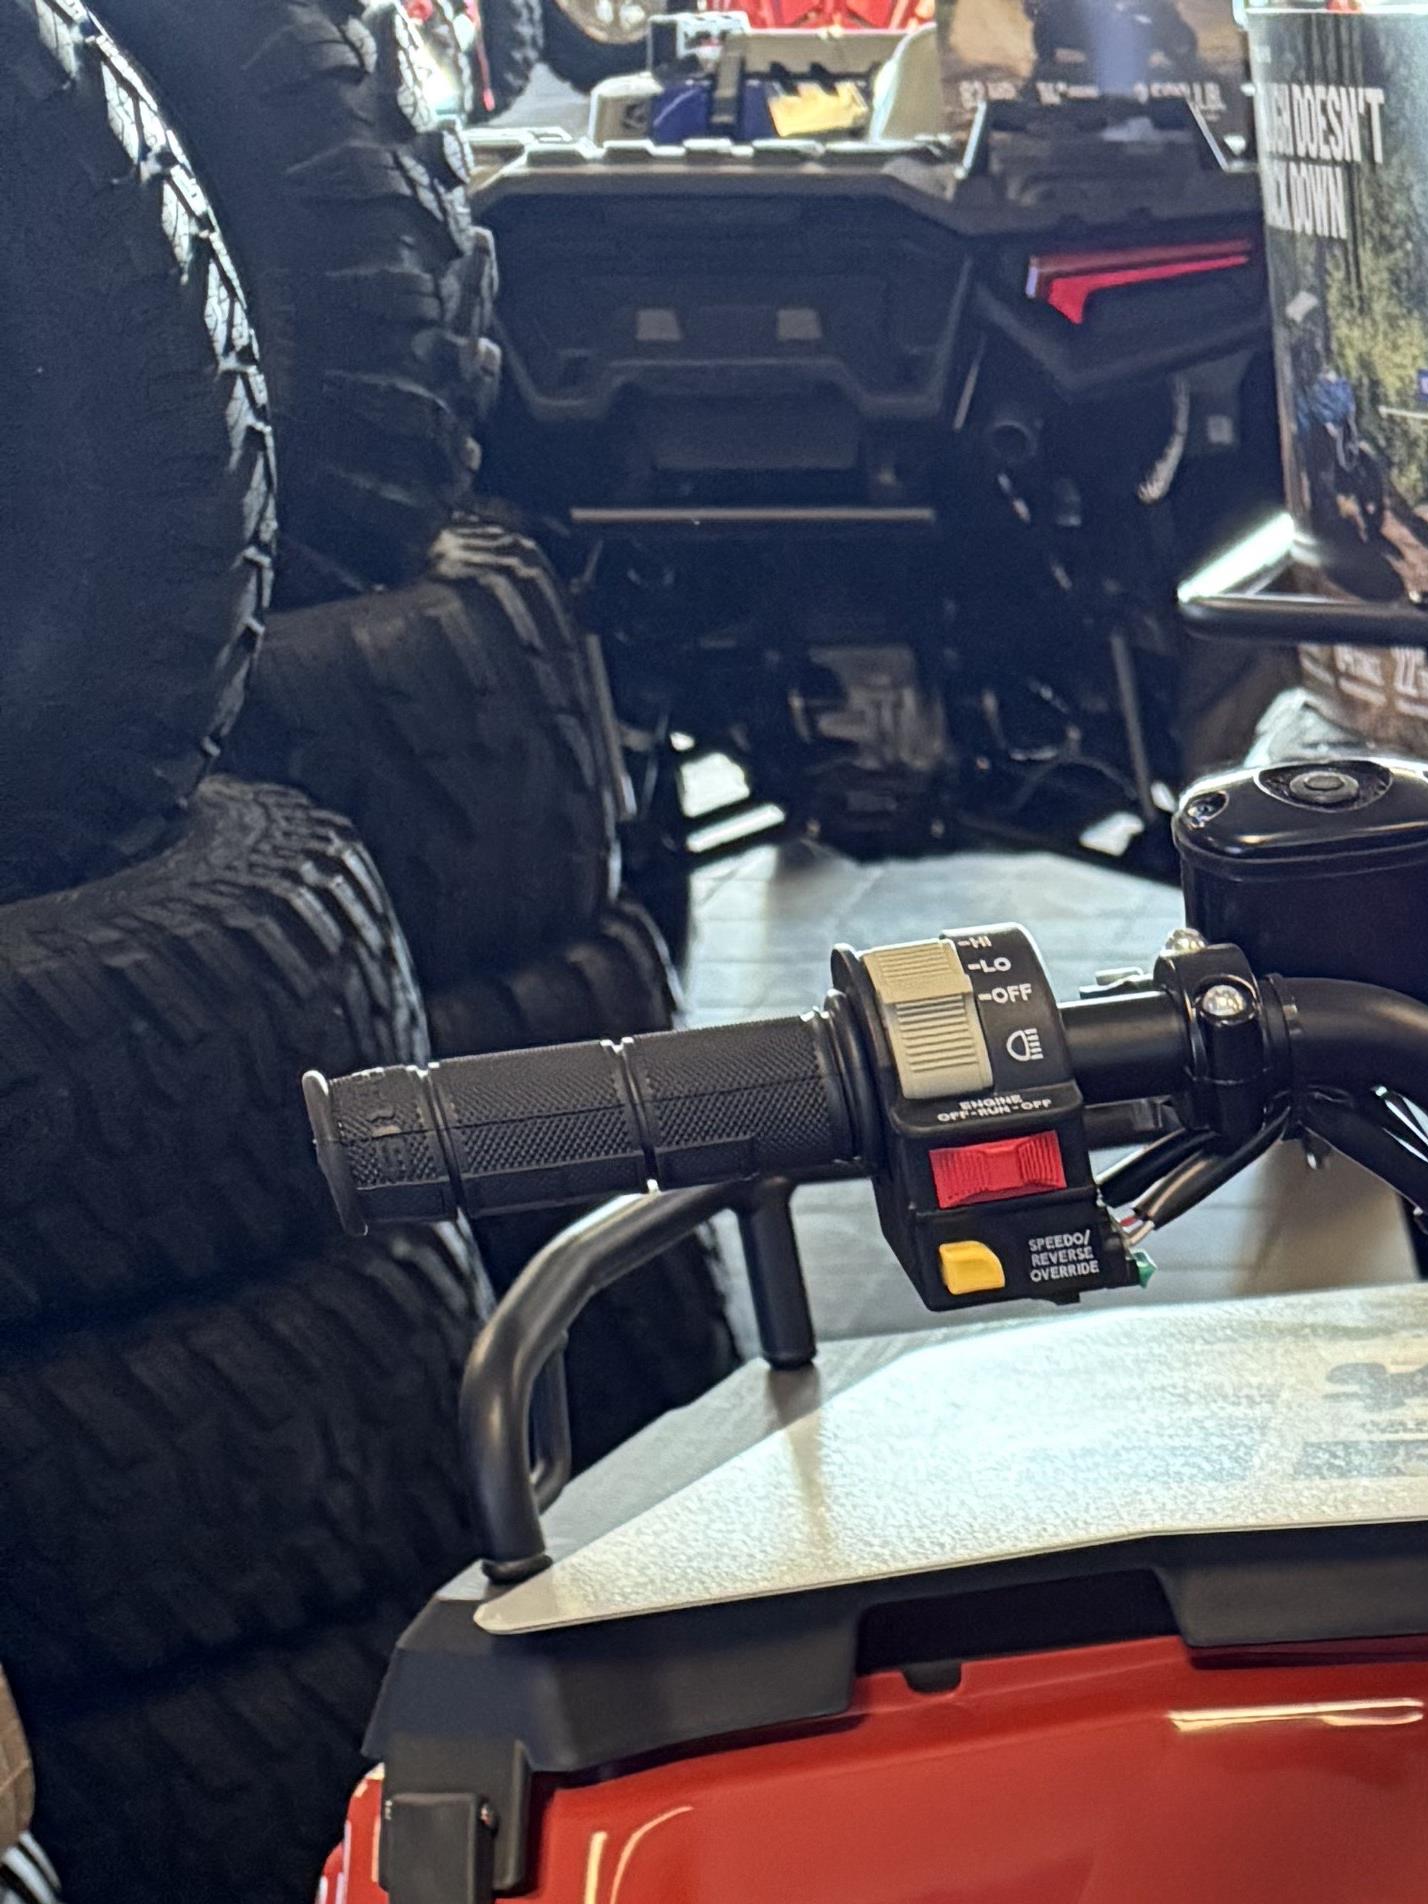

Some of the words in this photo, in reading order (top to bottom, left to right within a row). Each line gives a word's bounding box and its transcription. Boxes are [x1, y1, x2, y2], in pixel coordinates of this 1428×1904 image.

[1292, 84, 1385, 164] DOESN'T
[1290, 162, 1347, 239] DOWN
[981, 958, 1012, 973] LO
[992, 983, 1032, 1003] OFF
[958, 1093, 1022, 1110] ENGINE
[1029, 1230, 1090, 1252] SPEEDO/
[1031, 1247, 1094, 1268] REVERSE
[1030, 1260, 1099, 1283] OVERRIDE
